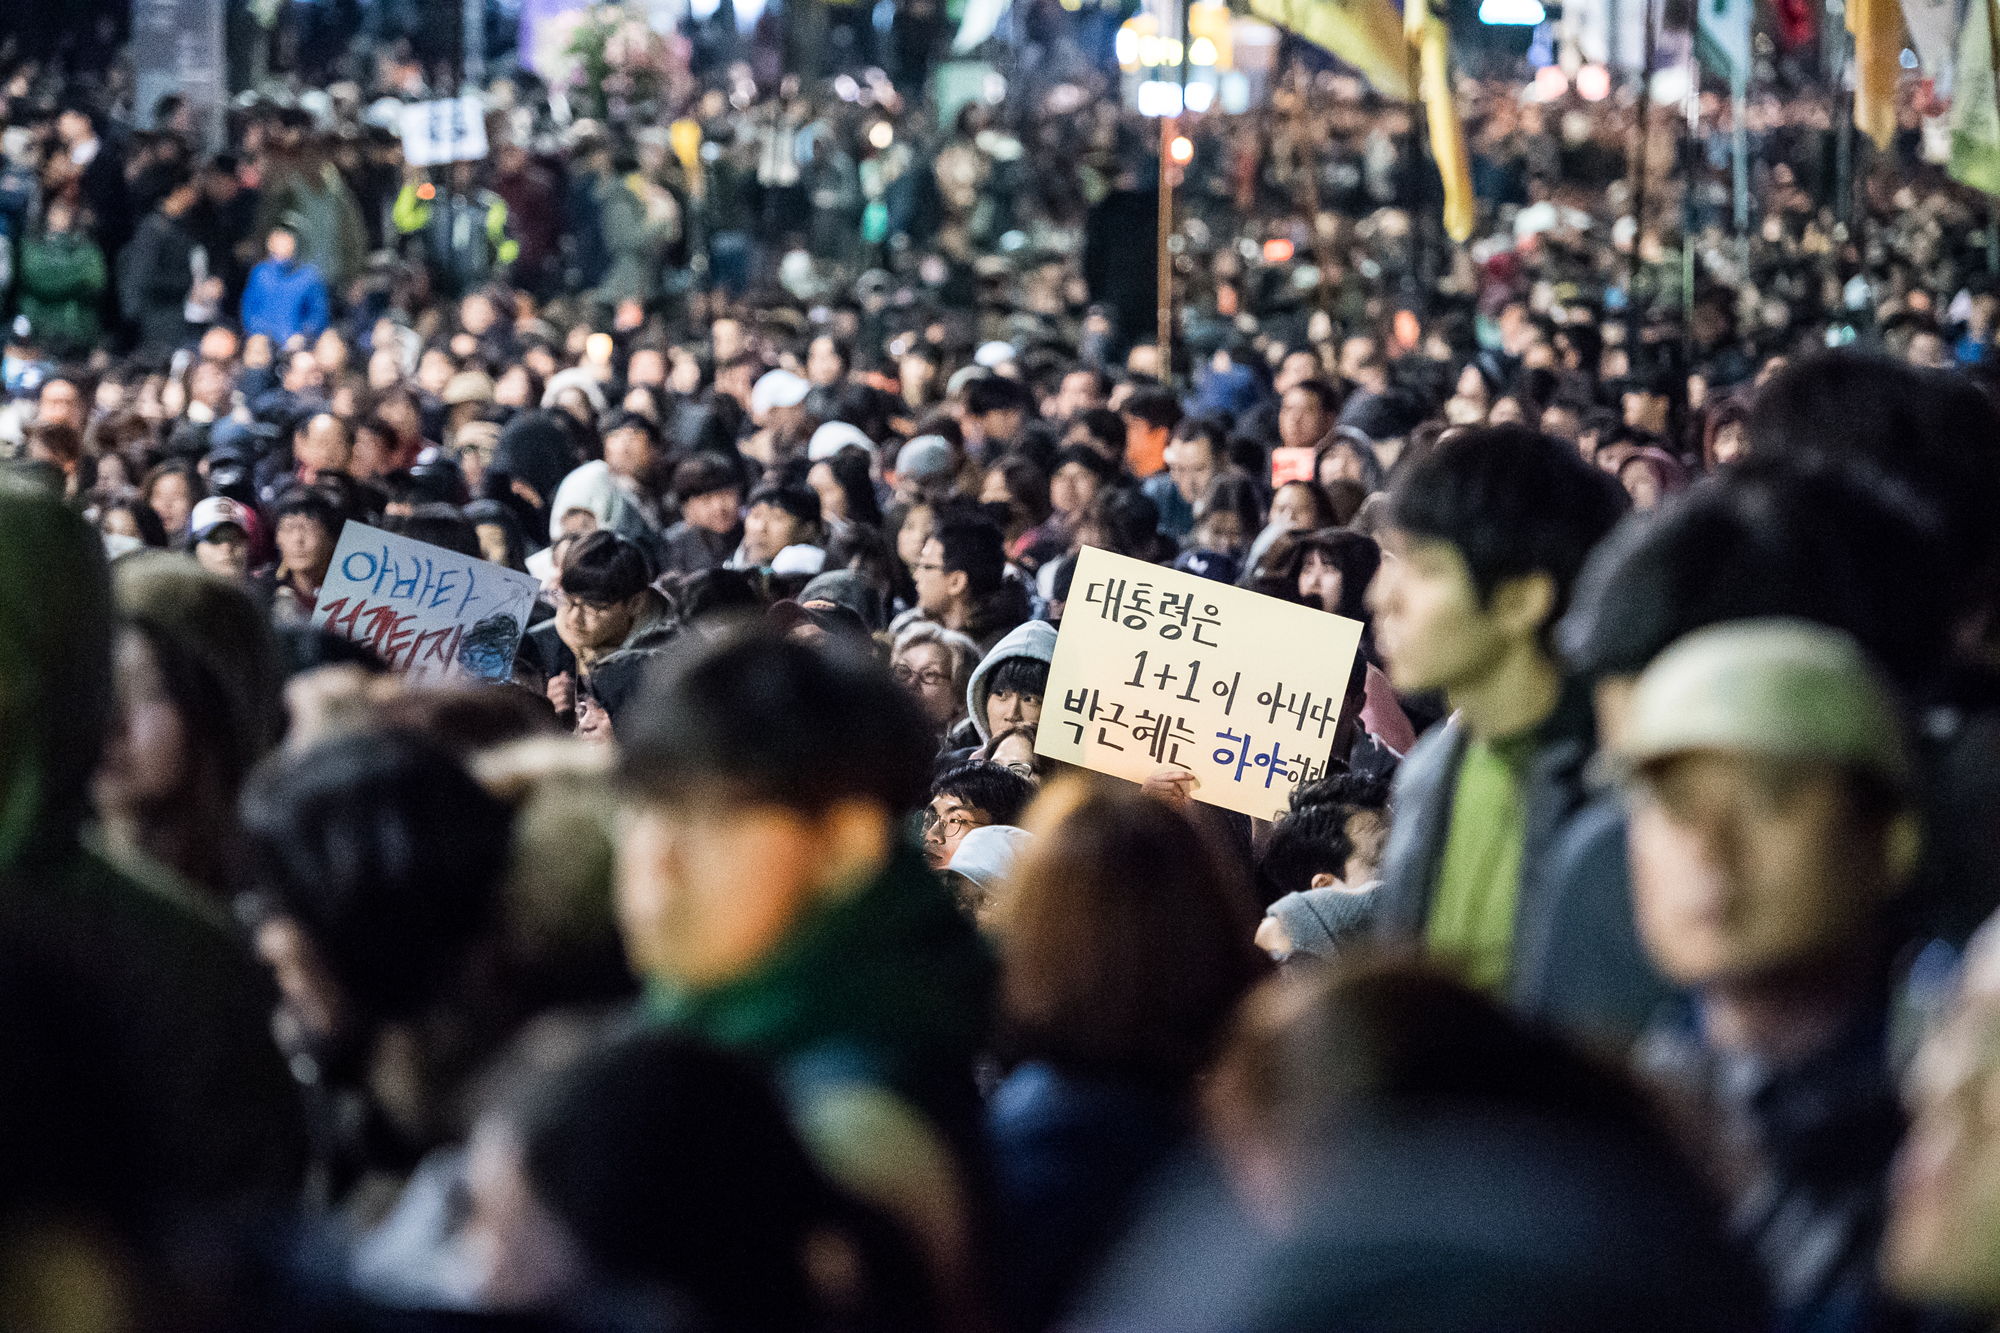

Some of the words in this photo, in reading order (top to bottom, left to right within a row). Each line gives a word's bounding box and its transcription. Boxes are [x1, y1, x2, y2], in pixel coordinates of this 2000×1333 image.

[342, 545, 481, 618] 아바타
[1085, 577, 1222, 648] 대통령은
[1063, 687, 1196, 771] 박근혜는
[1257, 682, 1336, 739] 아니다
